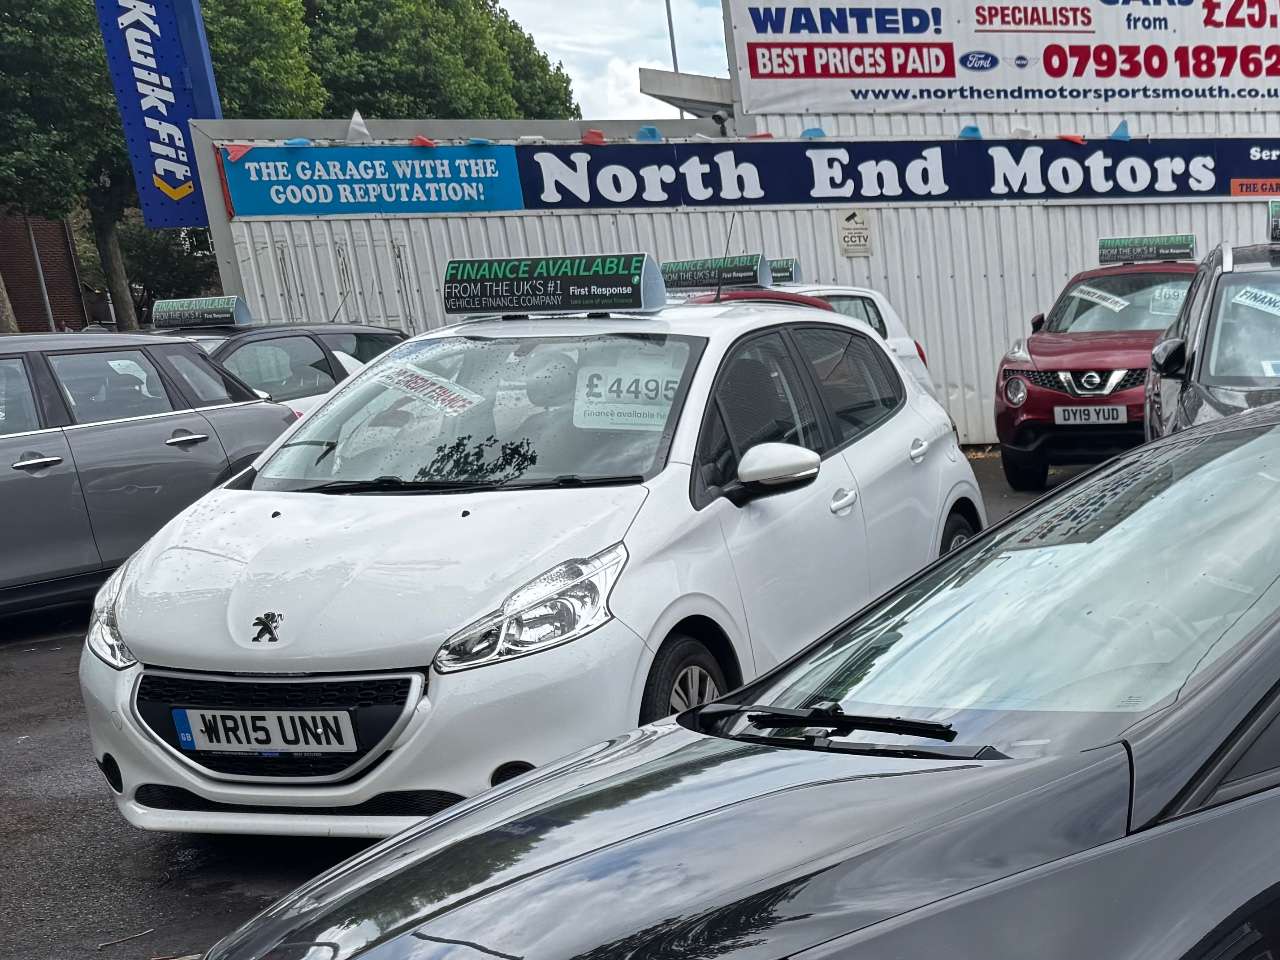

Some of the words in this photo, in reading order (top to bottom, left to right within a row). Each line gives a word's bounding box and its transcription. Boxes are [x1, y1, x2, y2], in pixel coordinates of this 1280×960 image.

[748, 7, 942, 35] WANTED!
[975, 6, 1092, 25] SPECIALISTS
[1126, 14, 1168, 30] from
[756, 48, 807, 74] BEST
[814, 48, 885, 74] PRICES
[892, 48, 946, 74] PAID
[963, 53, 994, 69] Ford
[1043, 45, 1168, 78] 07930
[245, 161, 291, 181] THE
[296, 160, 388, 181] GARAGE
[392, 159, 451, 180] WITH
[455, 158, 498, 178] THE
[533, 149, 765, 203] North
[805, 146, 950, 199] End
[988, 146, 1216, 194] Motors
[270, 184, 333, 204] GOOD
[337, 182, 485, 203] REPUTATION!
[1239, 183, 1258, 193] THE
[843, 234, 869, 244] CCTV
[446, 260, 531, 281] FINANCE
[533, 256, 643, 278] AVAILABLE
[703, 255, 759, 270] AVAILABLE
[445, 282, 483, 298] FROM
[484, 282, 510, 296] THE
[513, 280, 544, 295] UK'S
[547, 280, 562, 294] #1
[569, 287, 588, 296] First
[591, 285, 632, 297] Response
[155, 301, 190, 312] FINANCE
[190, 298, 236, 310] AVAILABLE
[446, 297, 480, 309] VEHICLE
[482, 296, 520, 308] FINANCE
[520, 295, 562, 307] COMPANY
[585, 373, 679, 401] £4495
[583, 409, 615, 418] Finance
[616, 410, 655, 419] available
[1063, 408, 1091, 421] DY19
[1094, 407, 1119, 421] YUD
[180, 732, 192, 742] GB
[201, 713, 272, 745] WR15
[277, 715, 345, 746] UNN
